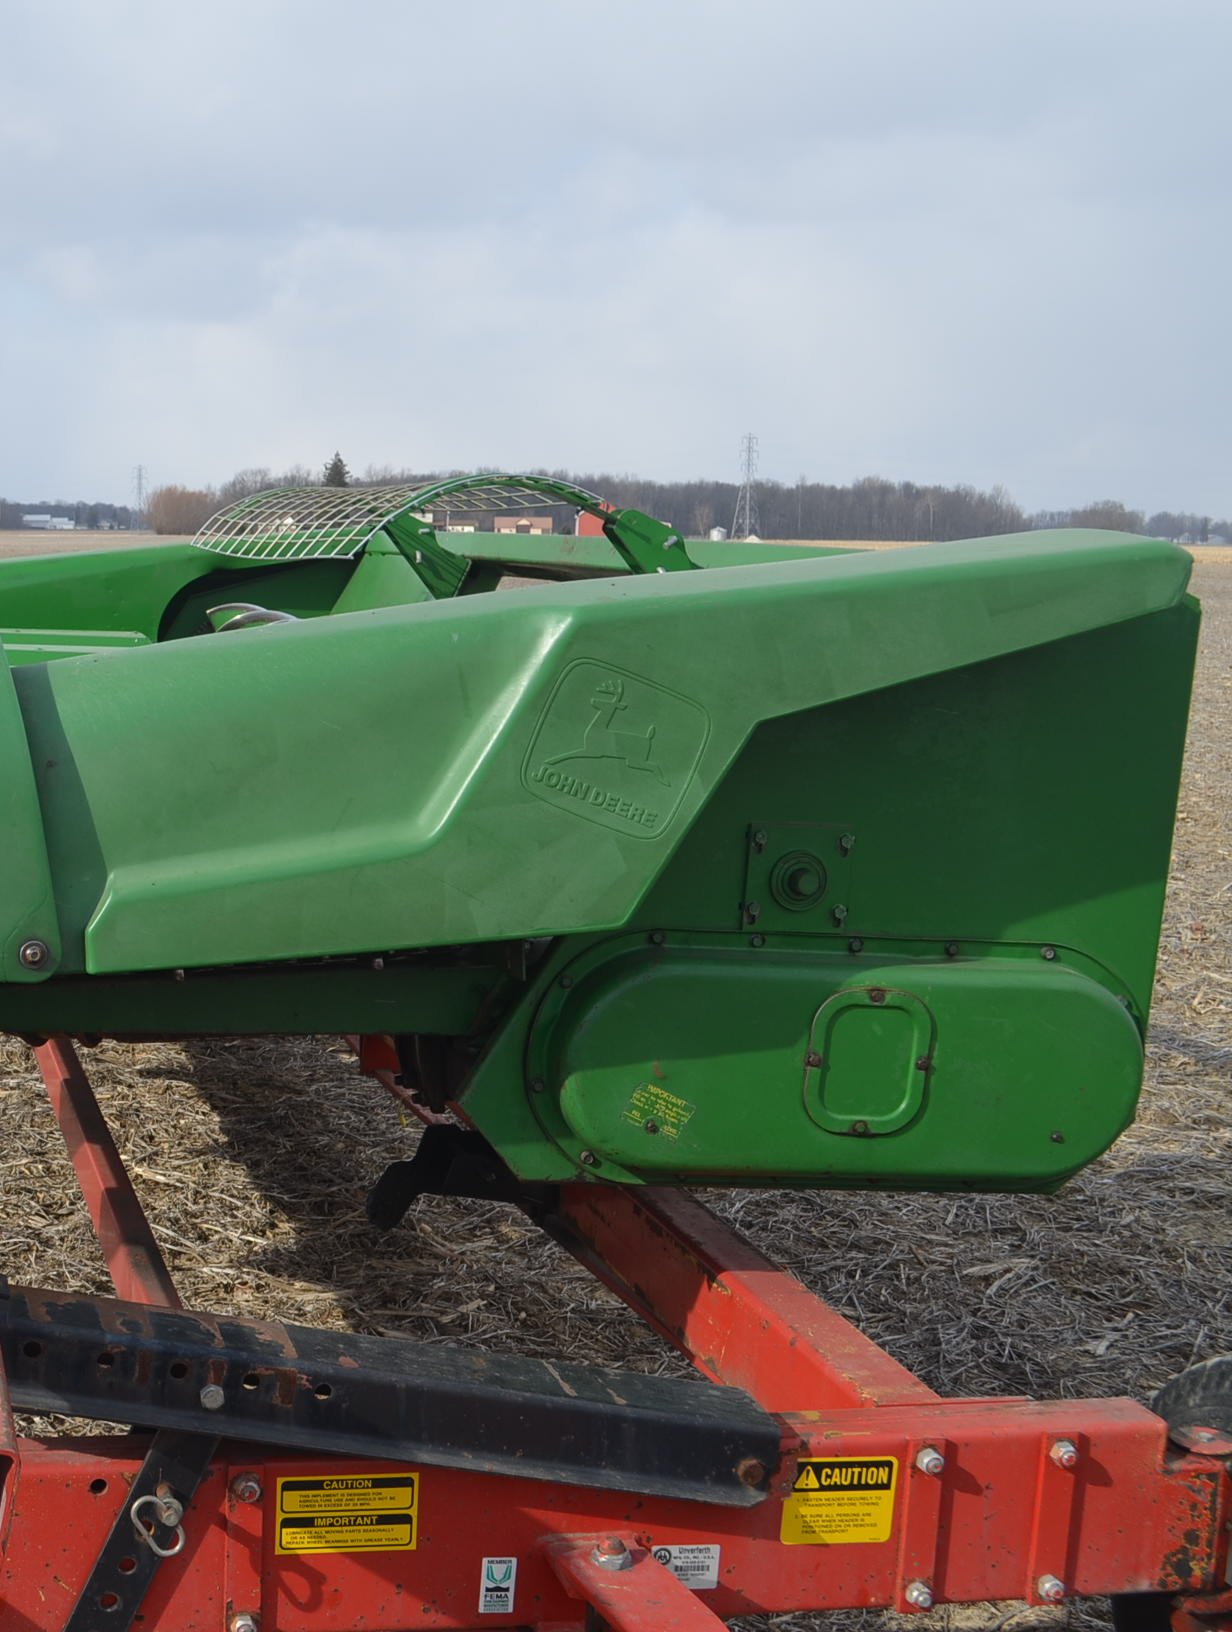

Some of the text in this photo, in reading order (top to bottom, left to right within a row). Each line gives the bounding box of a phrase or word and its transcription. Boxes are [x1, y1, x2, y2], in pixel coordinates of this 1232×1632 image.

[531, 766, 658, 828] JOHN DEERE
[821, 1466, 889, 1486] CAUTION
[323, 1480, 372, 1489] CAUTION
[314, 1516, 378, 1526] IMPORTANT
